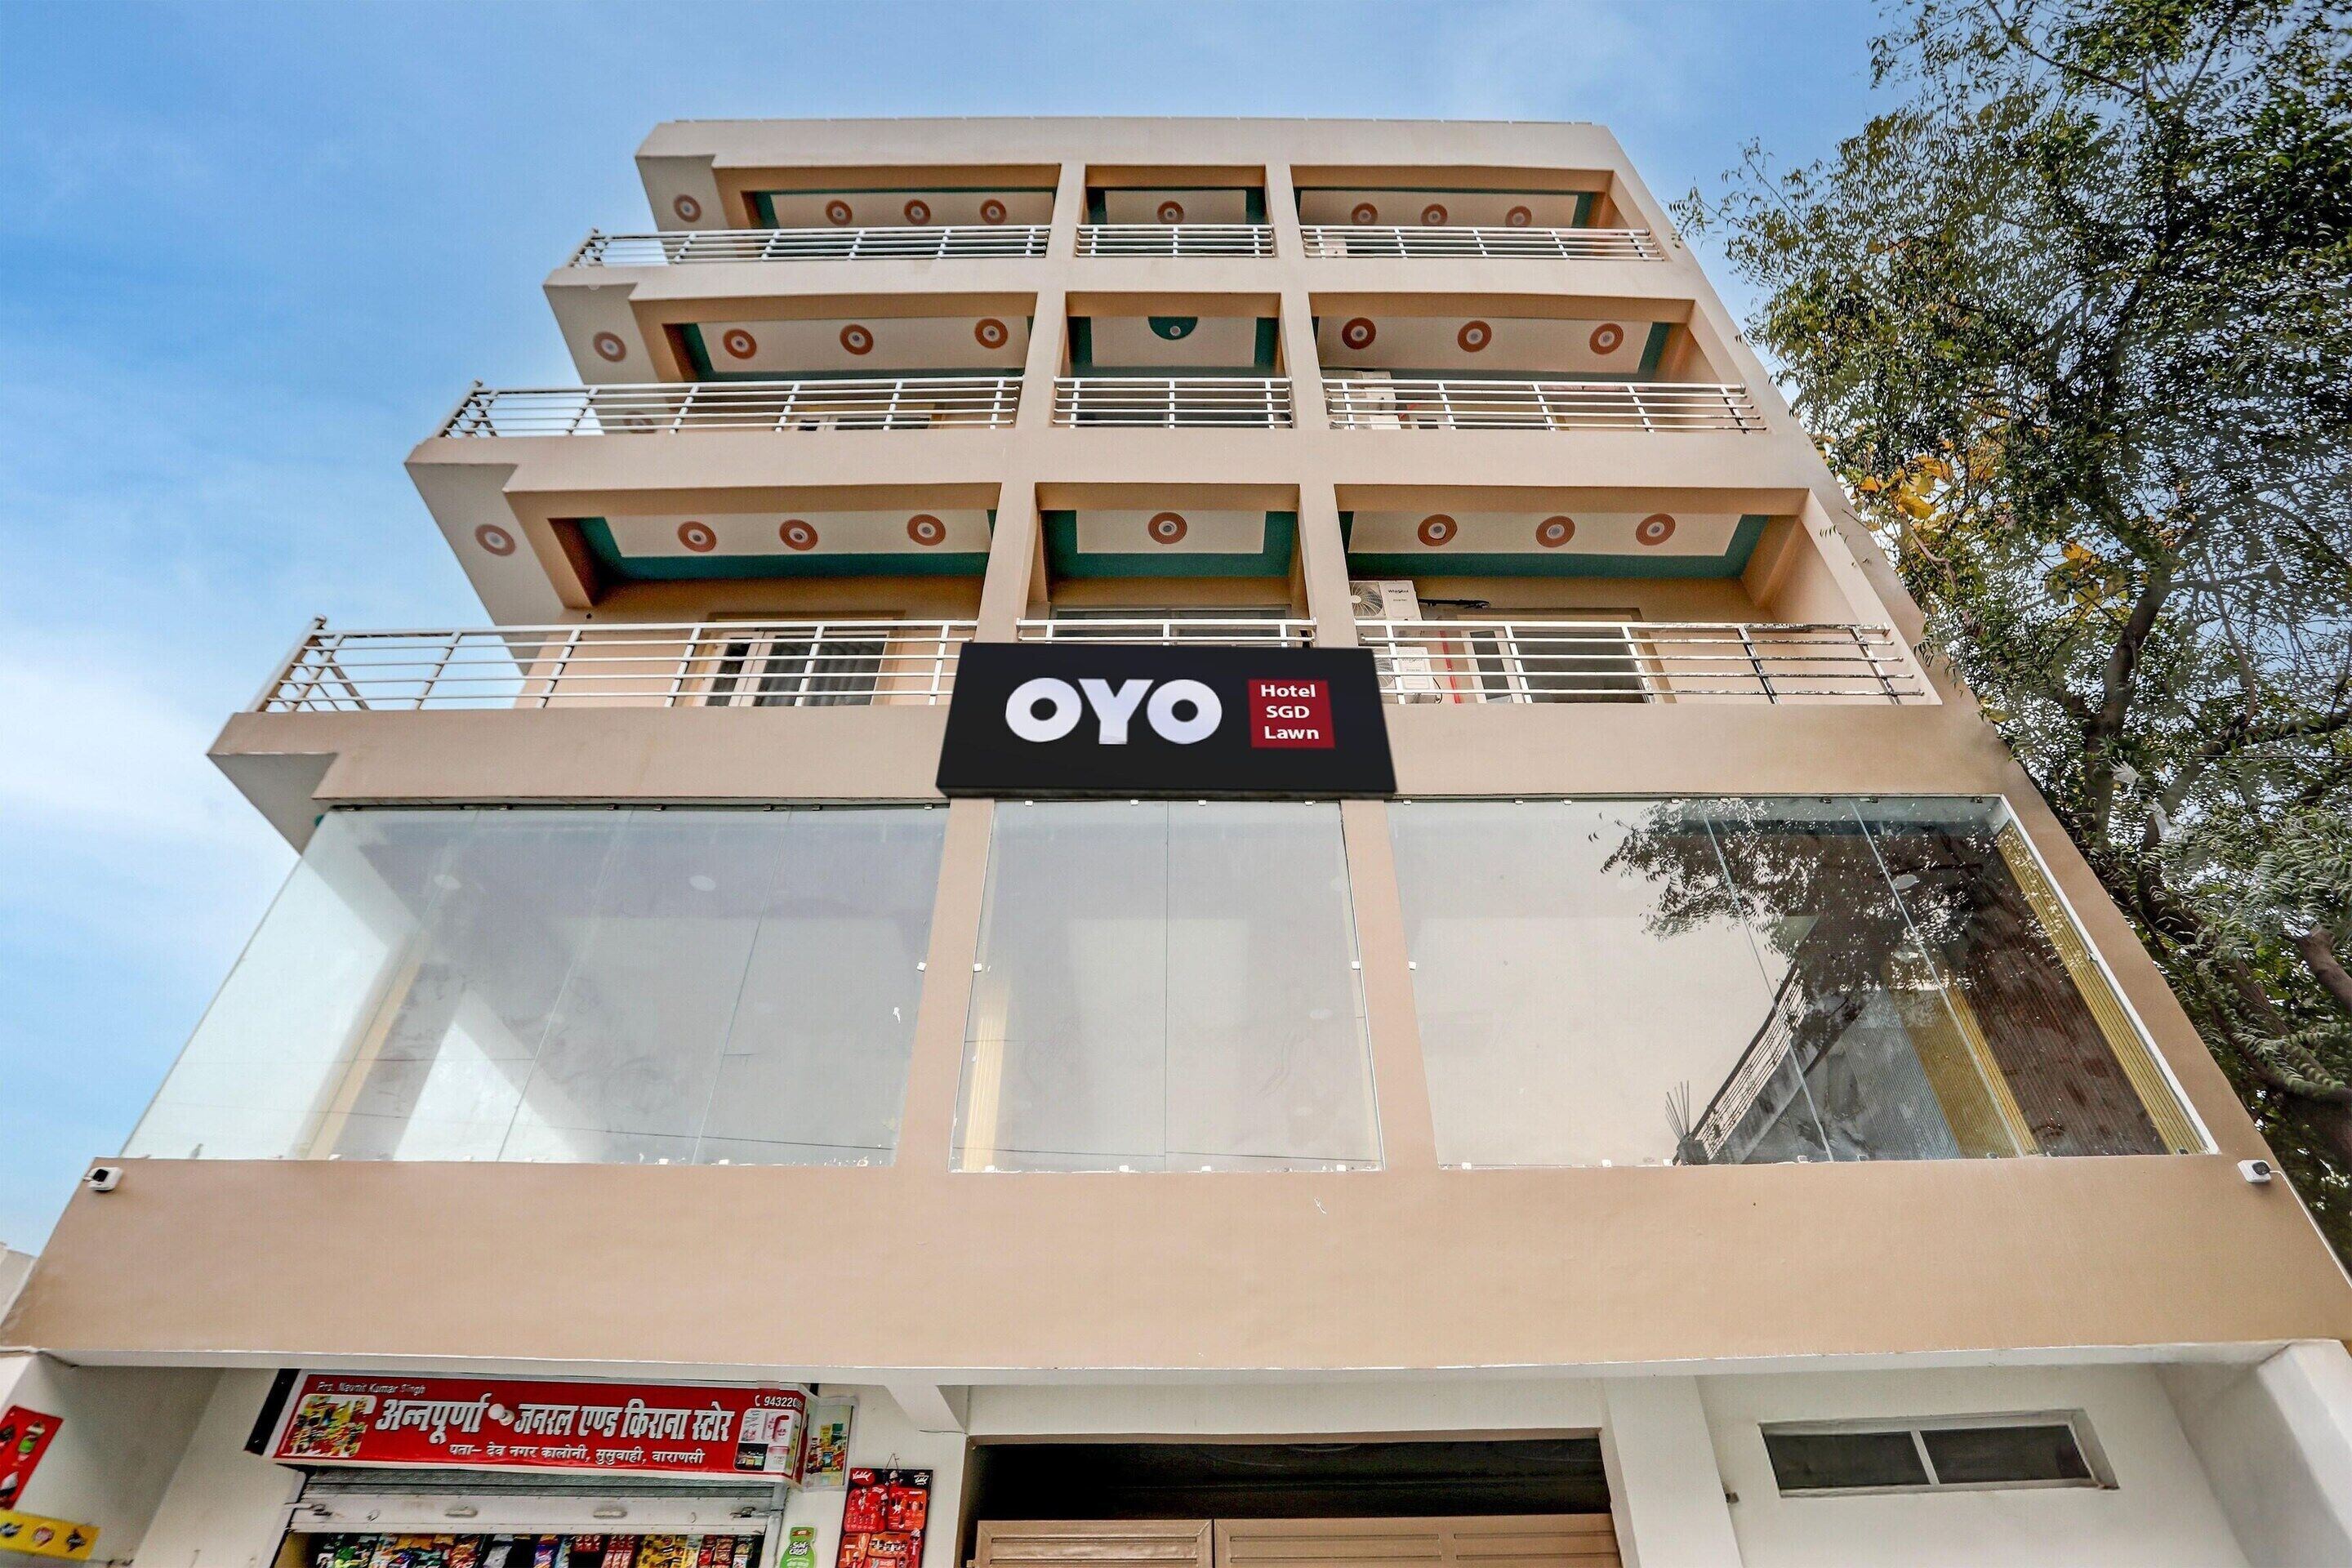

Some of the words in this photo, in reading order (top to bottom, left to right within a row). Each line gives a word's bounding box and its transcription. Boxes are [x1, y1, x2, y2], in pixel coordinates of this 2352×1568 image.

[1260, 684, 1316, 698] Hotel
[1005, 677, 1223, 745] OYO
[1266, 705, 1311, 719] SGD
[1264, 724, 1320, 740] Lawn
[375, 1393, 492, 1444] अन्नपूर्णा
[514, 1403, 579, 1436] जनरल
[577, 1405, 623, 1437] एण्ड
[620, 1398, 692, 1441] किराना
[692, 1401, 735, 1441] स्टोर
[510, 1446, 539, 1458] नगर
[652, 1448, 706, 1463] वाराणसी
